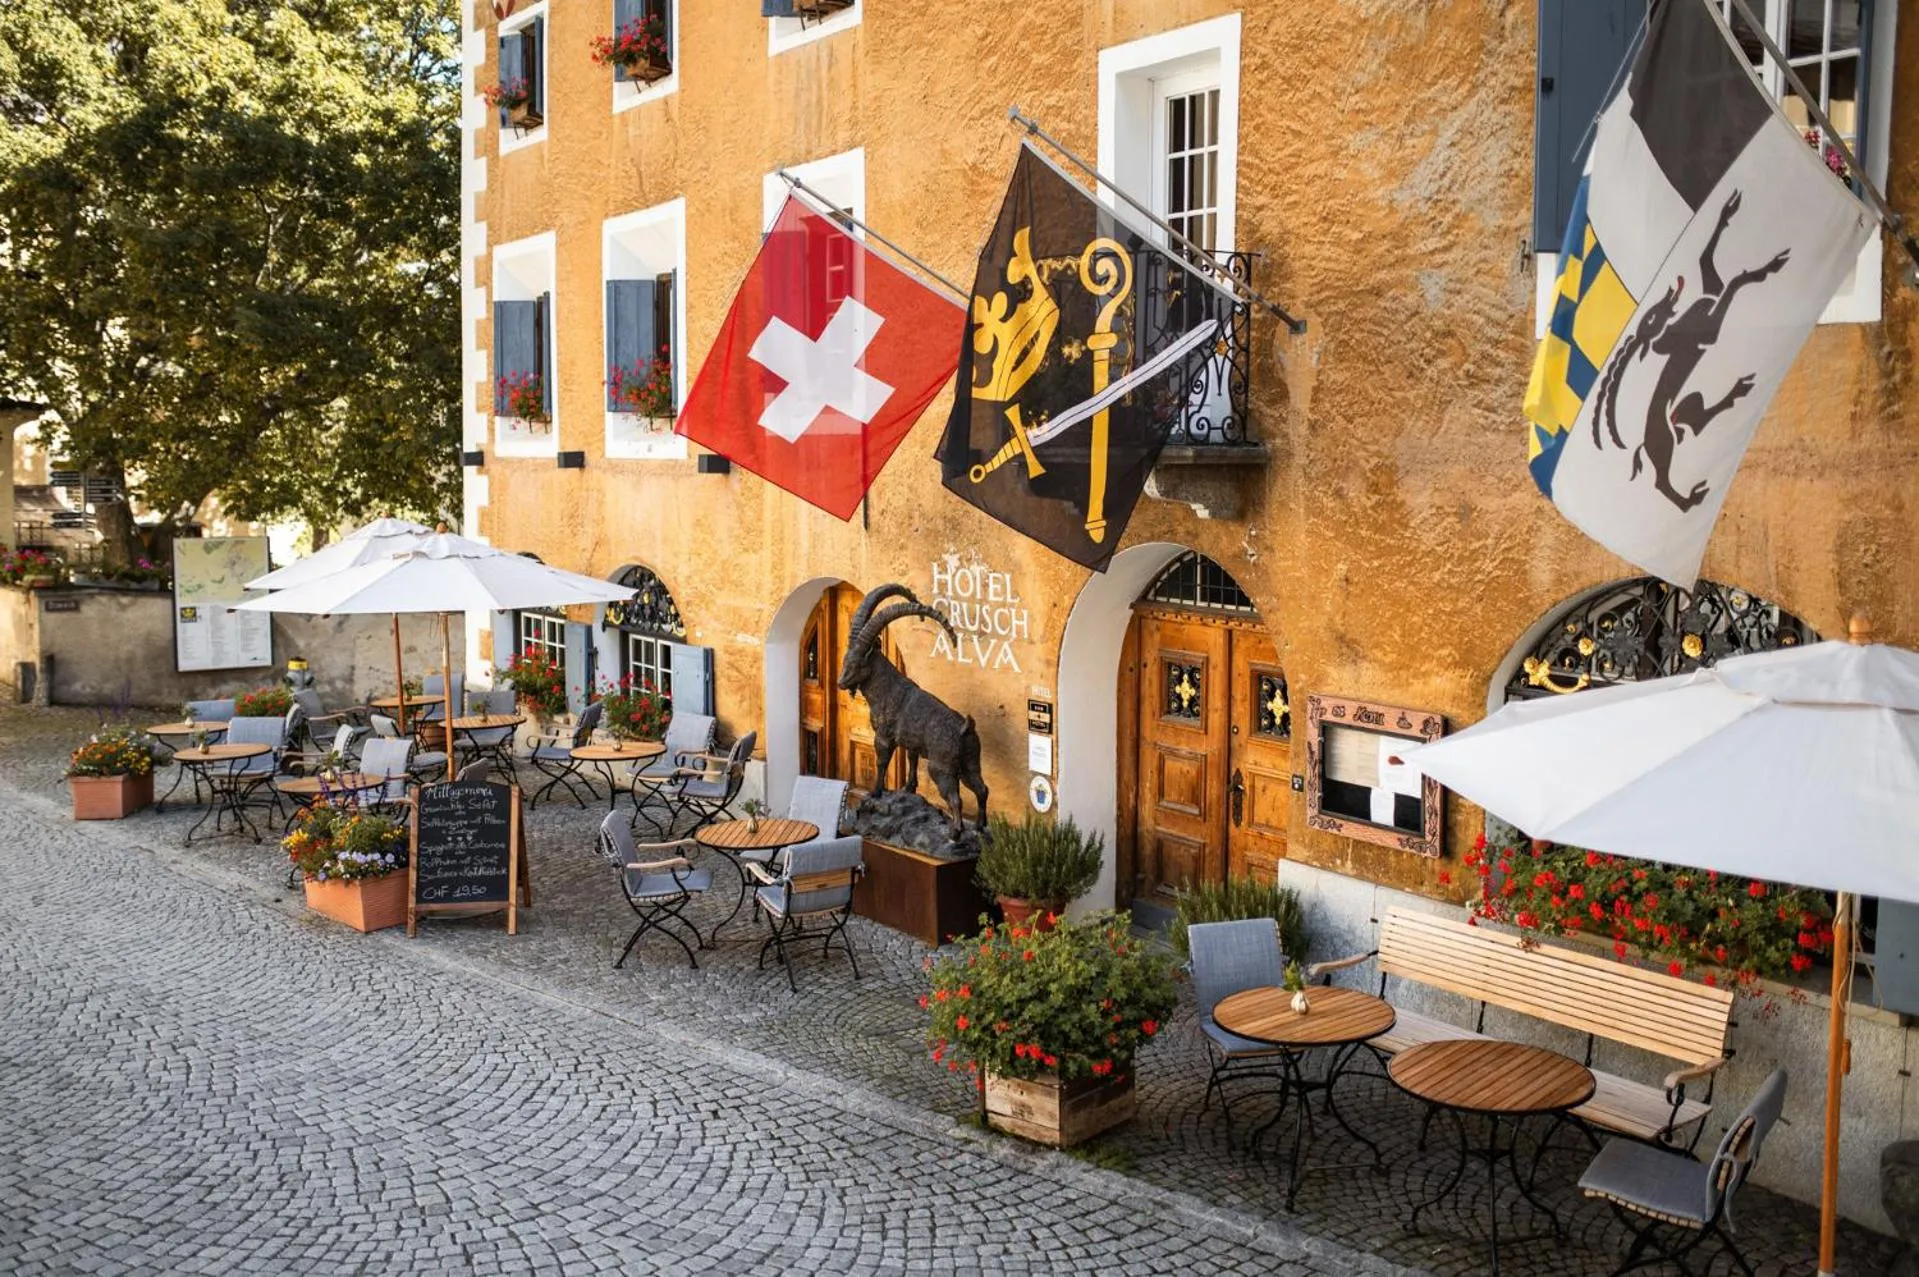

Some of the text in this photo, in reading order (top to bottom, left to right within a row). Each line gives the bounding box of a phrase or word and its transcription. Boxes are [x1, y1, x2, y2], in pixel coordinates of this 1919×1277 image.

[932, 562, 1020, 603] HOTEL
[930, 630, 1021, 672] ALVA
[422, 885, 449, 899] CHF
